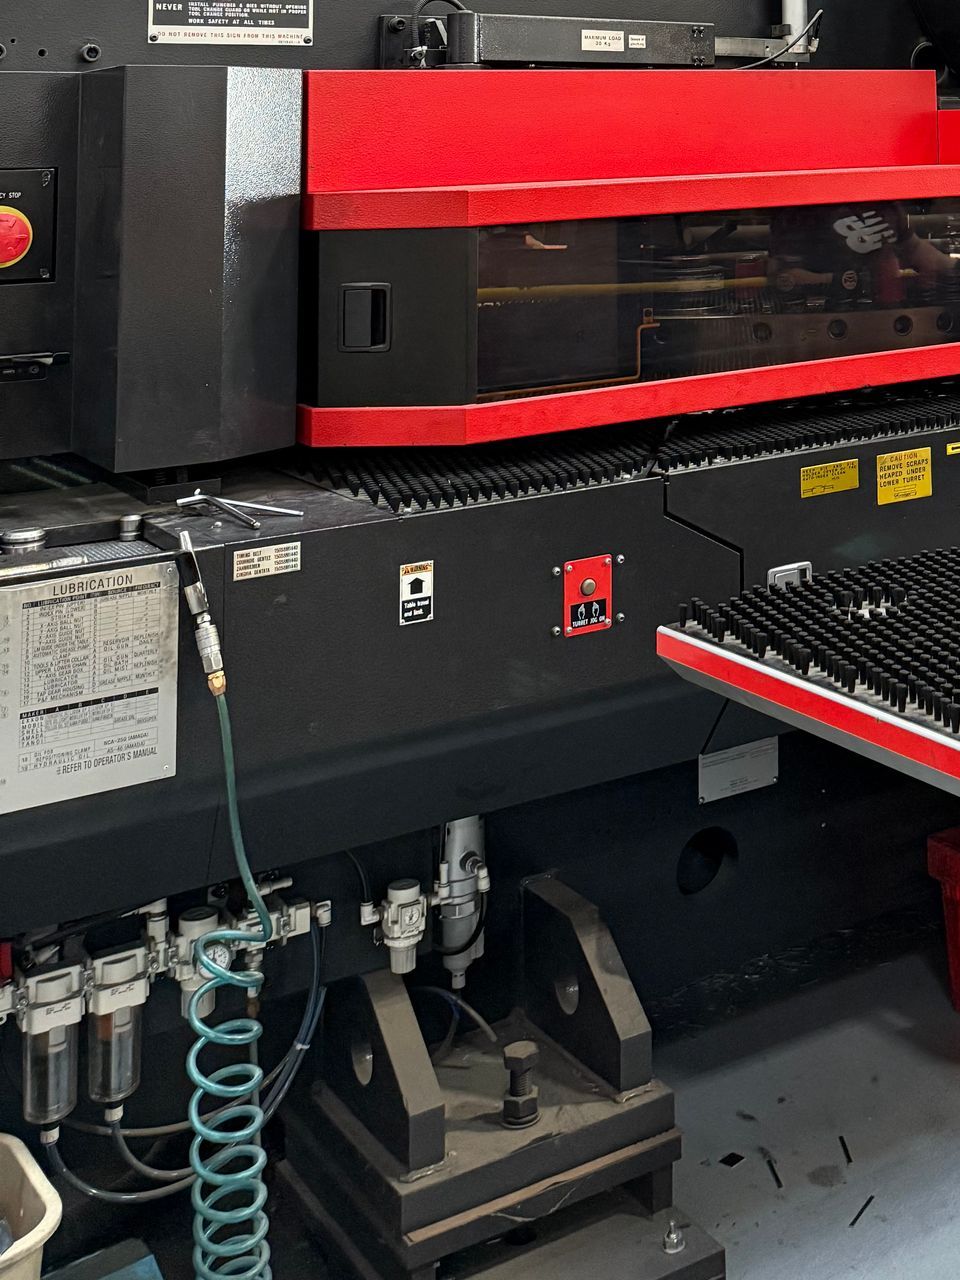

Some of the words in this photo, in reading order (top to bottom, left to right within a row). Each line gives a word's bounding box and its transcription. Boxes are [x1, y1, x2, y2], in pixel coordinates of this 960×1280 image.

[156, 3, 183, 11] NEVER
[890, 452, 918, 462] CAUTION
[880, 463, 903, 472] REMOVE
[906, 459, 928, 468] SCRAPS
[880, 471, 903, 480] HEAPED
[907, 467, 926, 475] UNDER
[880, 479, 899, 488] LOWER
[903, 474, 924, 484] TURRET
[53, 573, 133, 597] LUBRICATION
[404, 601, 416, 609] Table
[572, 619, 588, 628] TURRET
[62, 762, 81, 774] REFER
[84, 760, 92, 769] TO
[93, 751, 131, 768] OPERATOR'S
[133, 747, 158, 759] MANUAL
